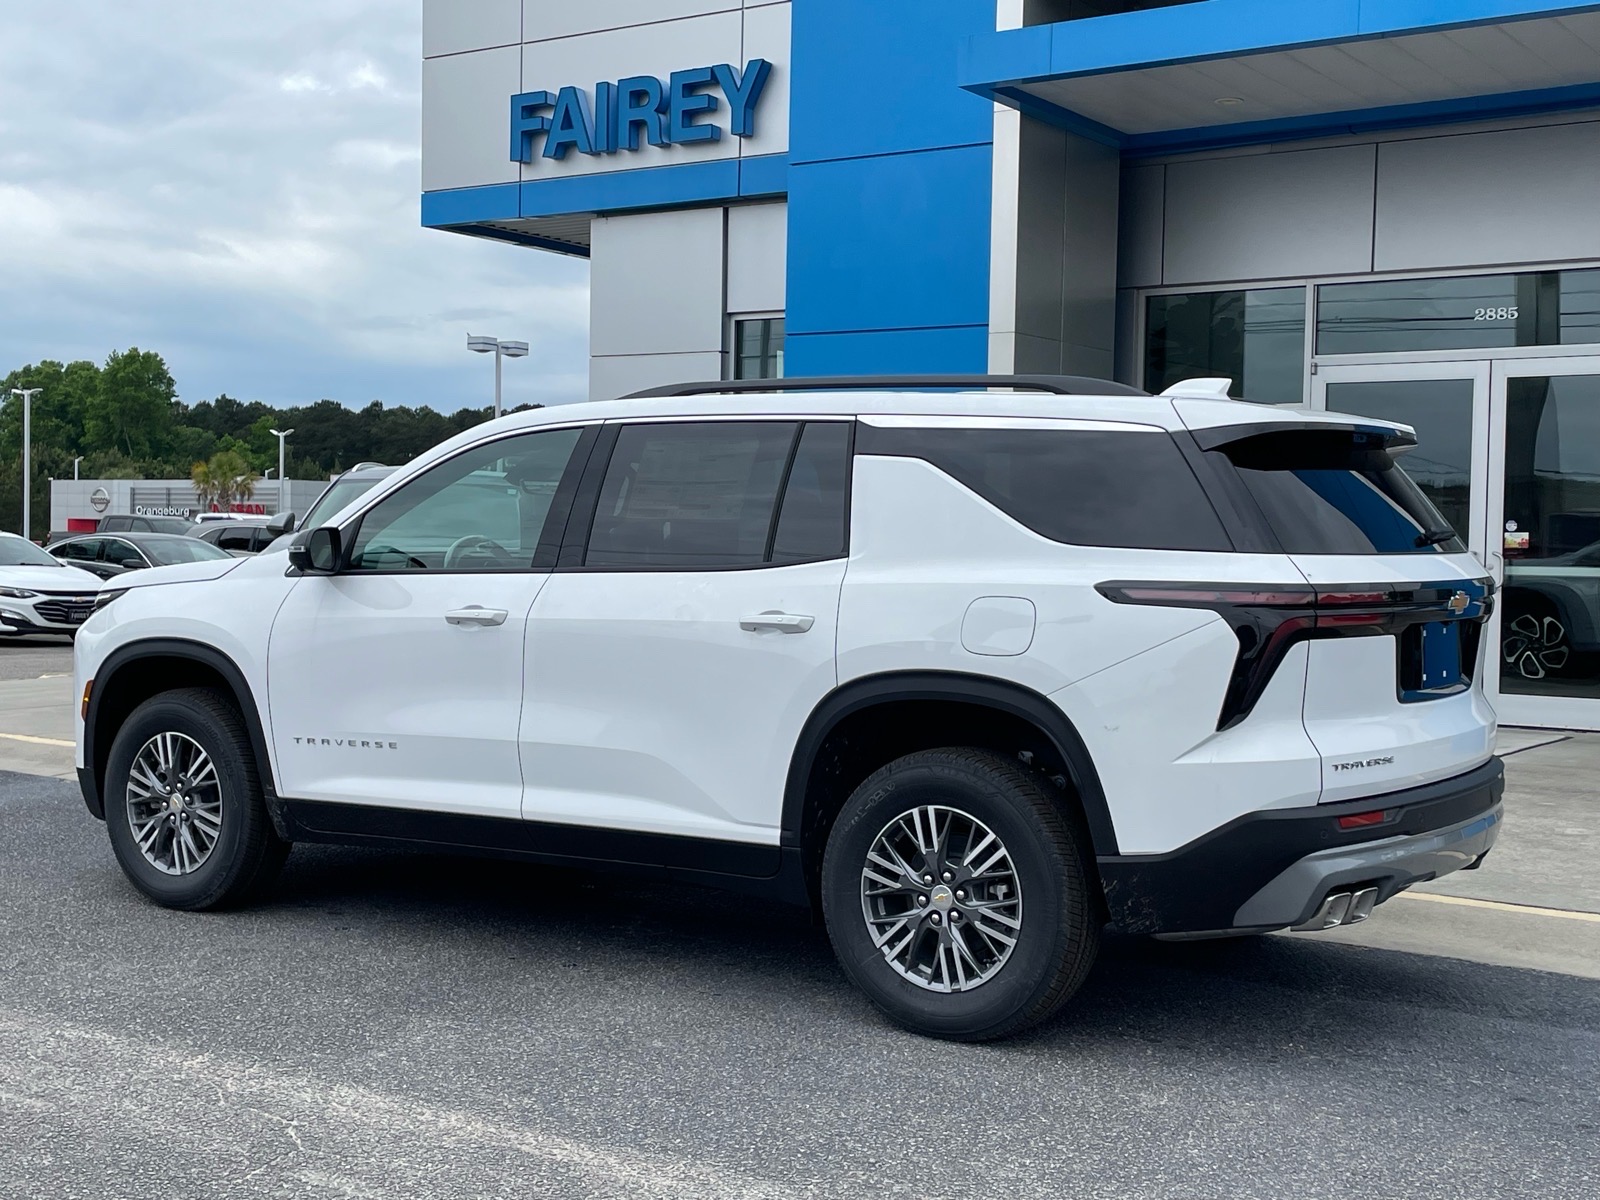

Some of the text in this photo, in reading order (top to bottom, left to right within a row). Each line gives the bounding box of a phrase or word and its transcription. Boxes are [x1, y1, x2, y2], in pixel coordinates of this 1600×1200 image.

[510, 58, 772, 164] FAIREY
[1474, 307, 1519, 320] 2885
[136, 505, 190, 517] Orangeburg
[293, 737, 398, 749] TRAVERSE
[1332, 756, 1394, 771] TRAVERSE
